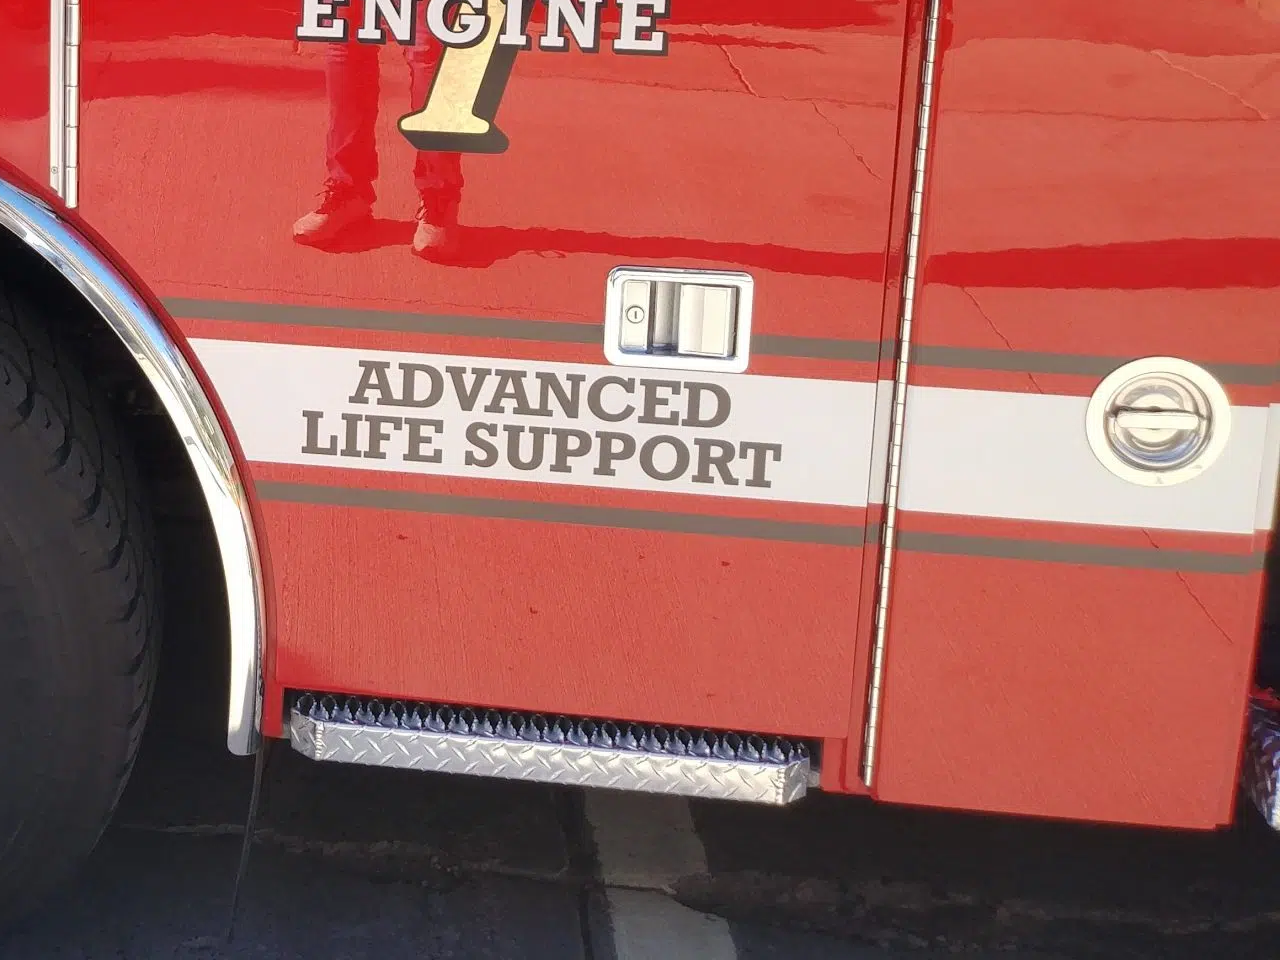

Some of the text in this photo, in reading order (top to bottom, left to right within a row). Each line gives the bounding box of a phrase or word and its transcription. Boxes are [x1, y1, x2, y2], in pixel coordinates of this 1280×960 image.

[348, 359, 732, 428] ADVANCED
[300, 410, 782, 487] LIFE SUPPORT
